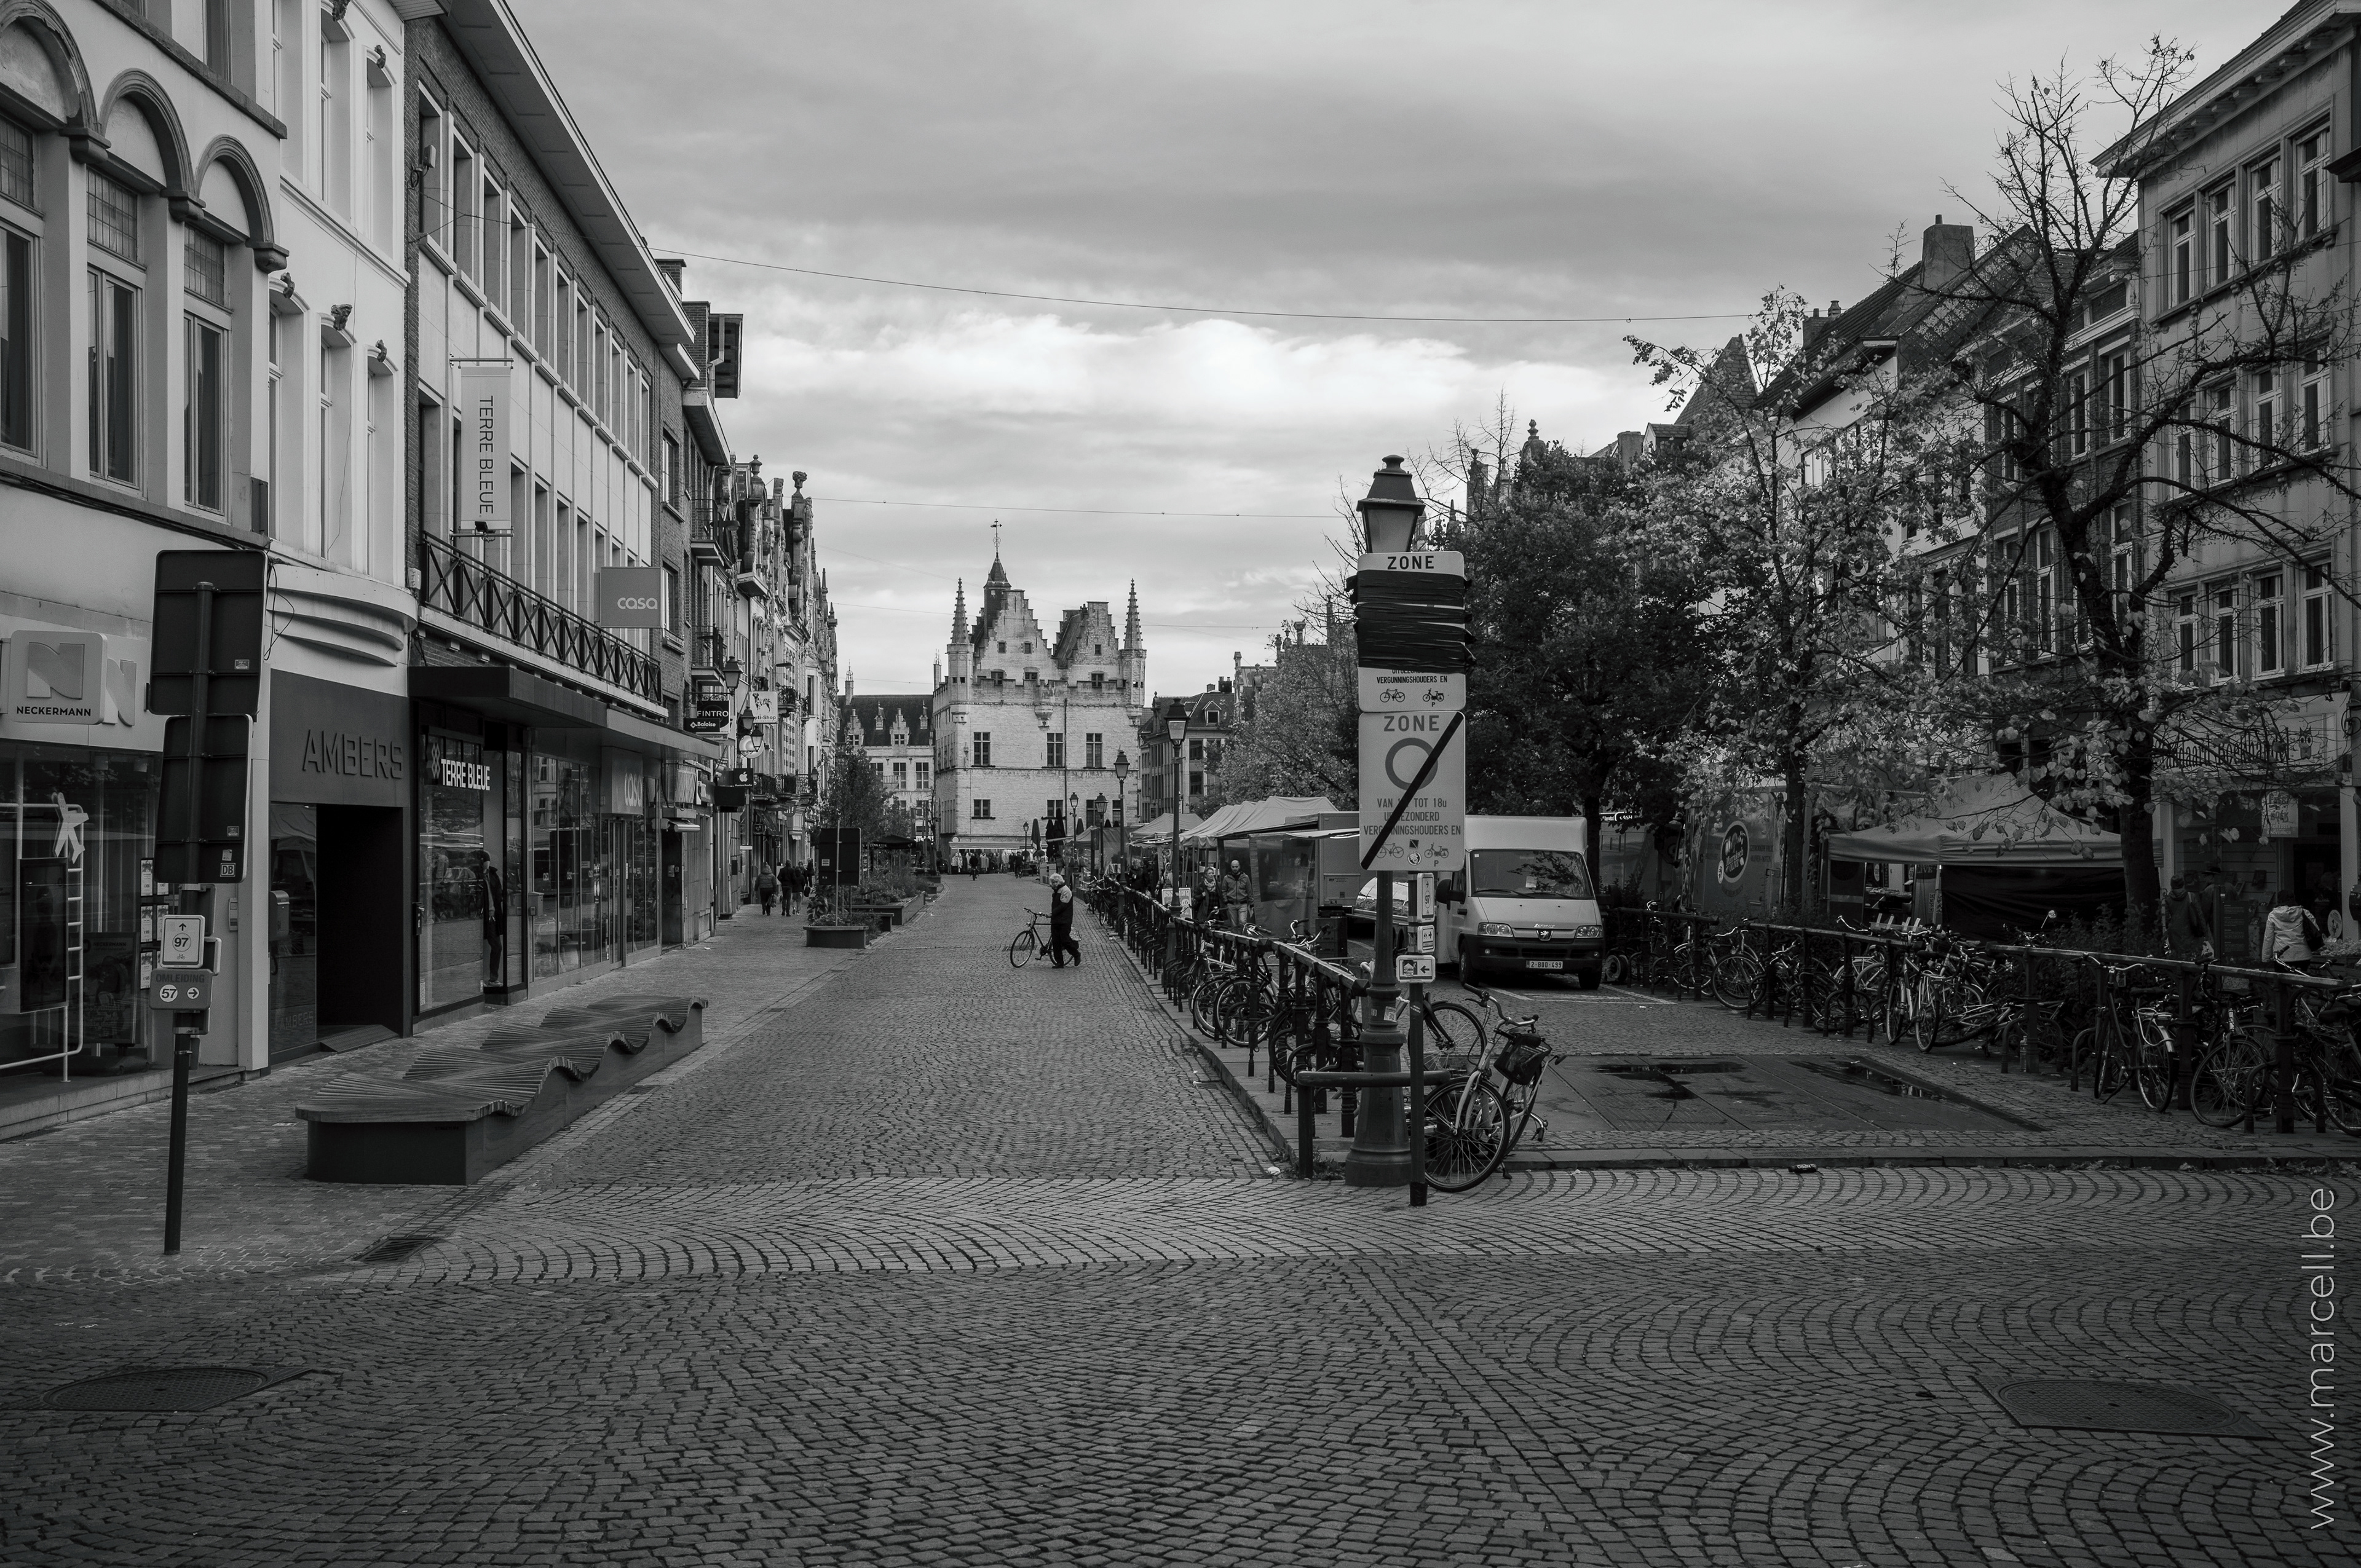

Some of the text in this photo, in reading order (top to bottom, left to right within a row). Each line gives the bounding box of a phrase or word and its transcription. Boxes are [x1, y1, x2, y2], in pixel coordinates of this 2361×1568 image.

[479, 395, 494, 514] TERRE BLEUE
[1387, 556, 1434, 570] ZONE
[617, 596, 658, 610] casa
[1377, 676, 1438, 684] VERGUNNINGSHOUDERS
[16, 706, 92, 717] NECKERMANN
[1384, 715, 1439, 731] ZONE
[302, 729, 403, 779] AMBERS
[441, 758, 491, 791] TERRE BLEUE
[1377, 798, 1393, 808] VAN
[1414, 798, 1428, 808] TOT
[1433, 798, 1447, 808] 18u
[1451, 825, 1461, 835] EN
[223, 865, 234, 874] DB
[1425, 895, 1430, 904] 97
[174, 937, 189, 947] 97
[156, 974, 205, 983] OMLEIDING
[161, 988, 177, 999] 57
[280, 1011, 314, 1030] AMBERS
